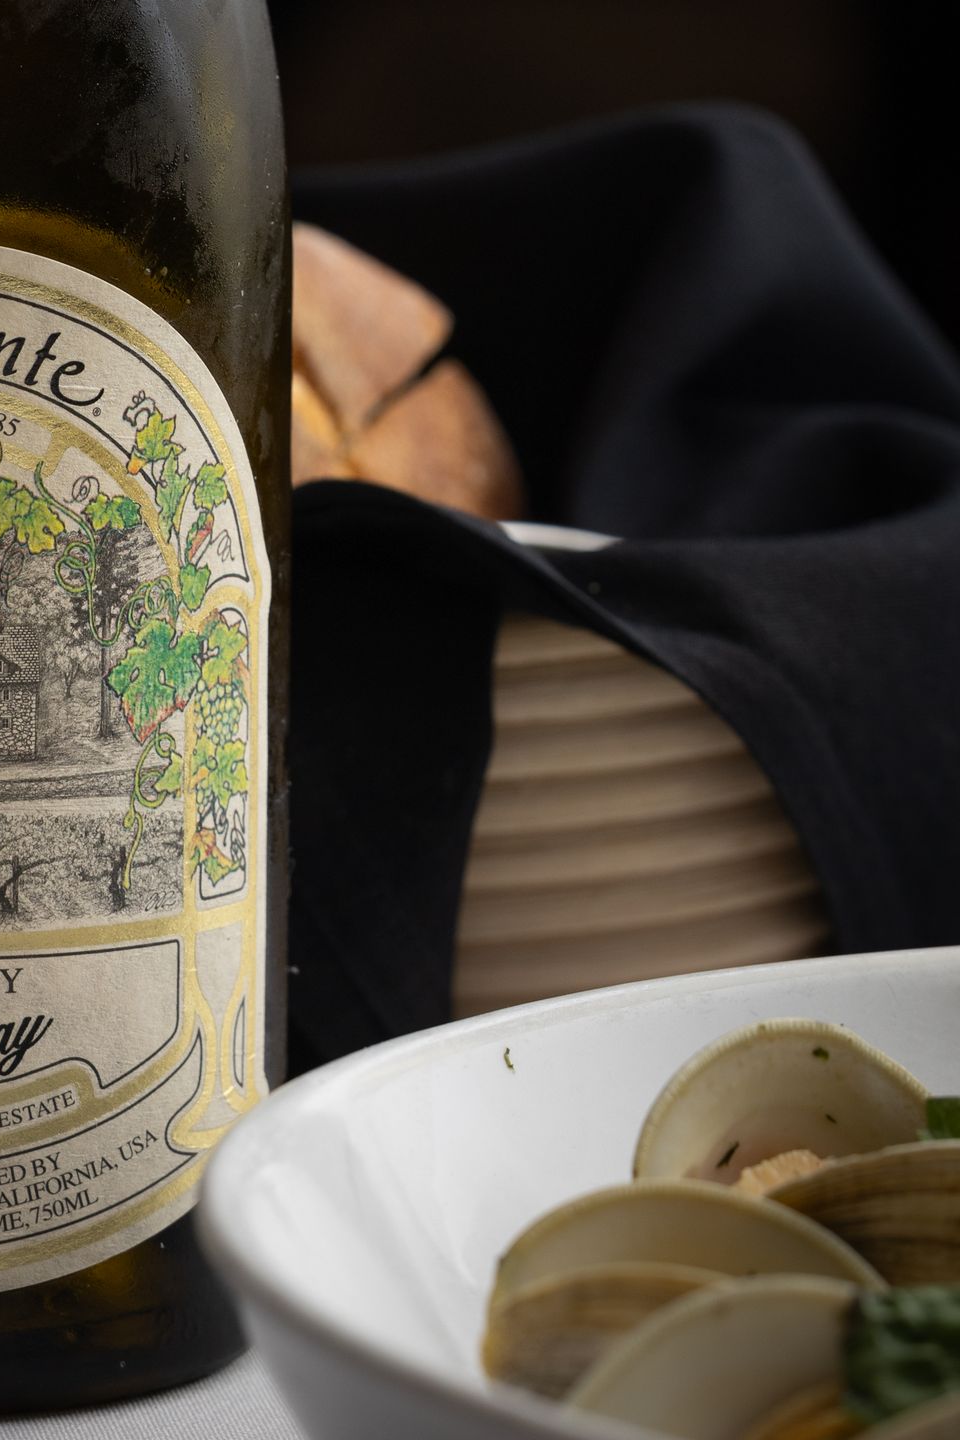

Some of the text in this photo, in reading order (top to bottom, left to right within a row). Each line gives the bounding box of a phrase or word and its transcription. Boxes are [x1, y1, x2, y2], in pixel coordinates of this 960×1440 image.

[117, 1128, 159, 1162] USA
[30, 1151, 62, 1177] BY
[28, 1188, 100, 1225] 750ML
